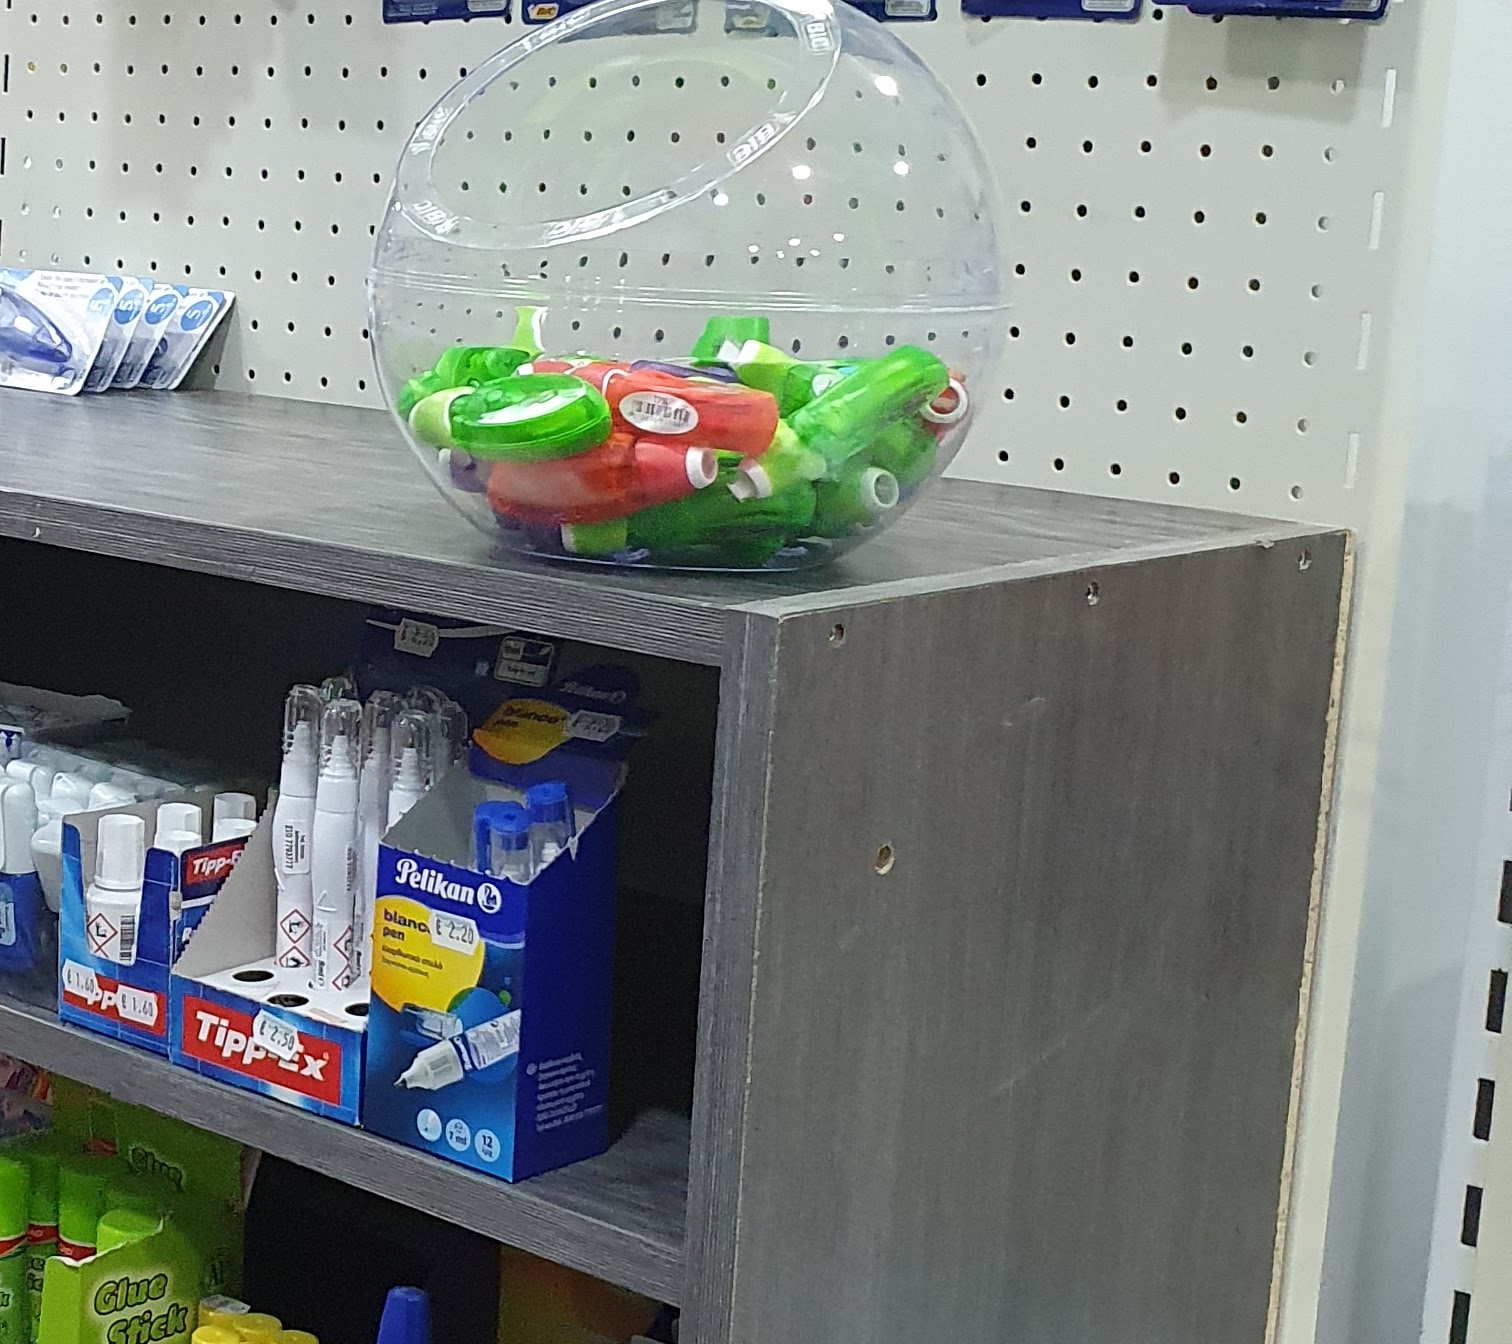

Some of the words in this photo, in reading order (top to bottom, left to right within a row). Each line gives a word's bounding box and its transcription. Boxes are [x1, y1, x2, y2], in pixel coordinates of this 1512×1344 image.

[193, 849, 245, 877] Tipp-E
[394, 857, 476, 906] Pelikan
[382, 925, 405, 942] pen
[383, 907, 431, 935] blanc
[449, 920, 474, 945] 2.20
[131, 994, 155, 1018] 1.60
[195, 1010, 326, 1082] Tippx
[269, 1024, 296, 1052] 2.50
[481, 1133, 493, 1149] 12
[94, 1273, 169, 1316] Glue
